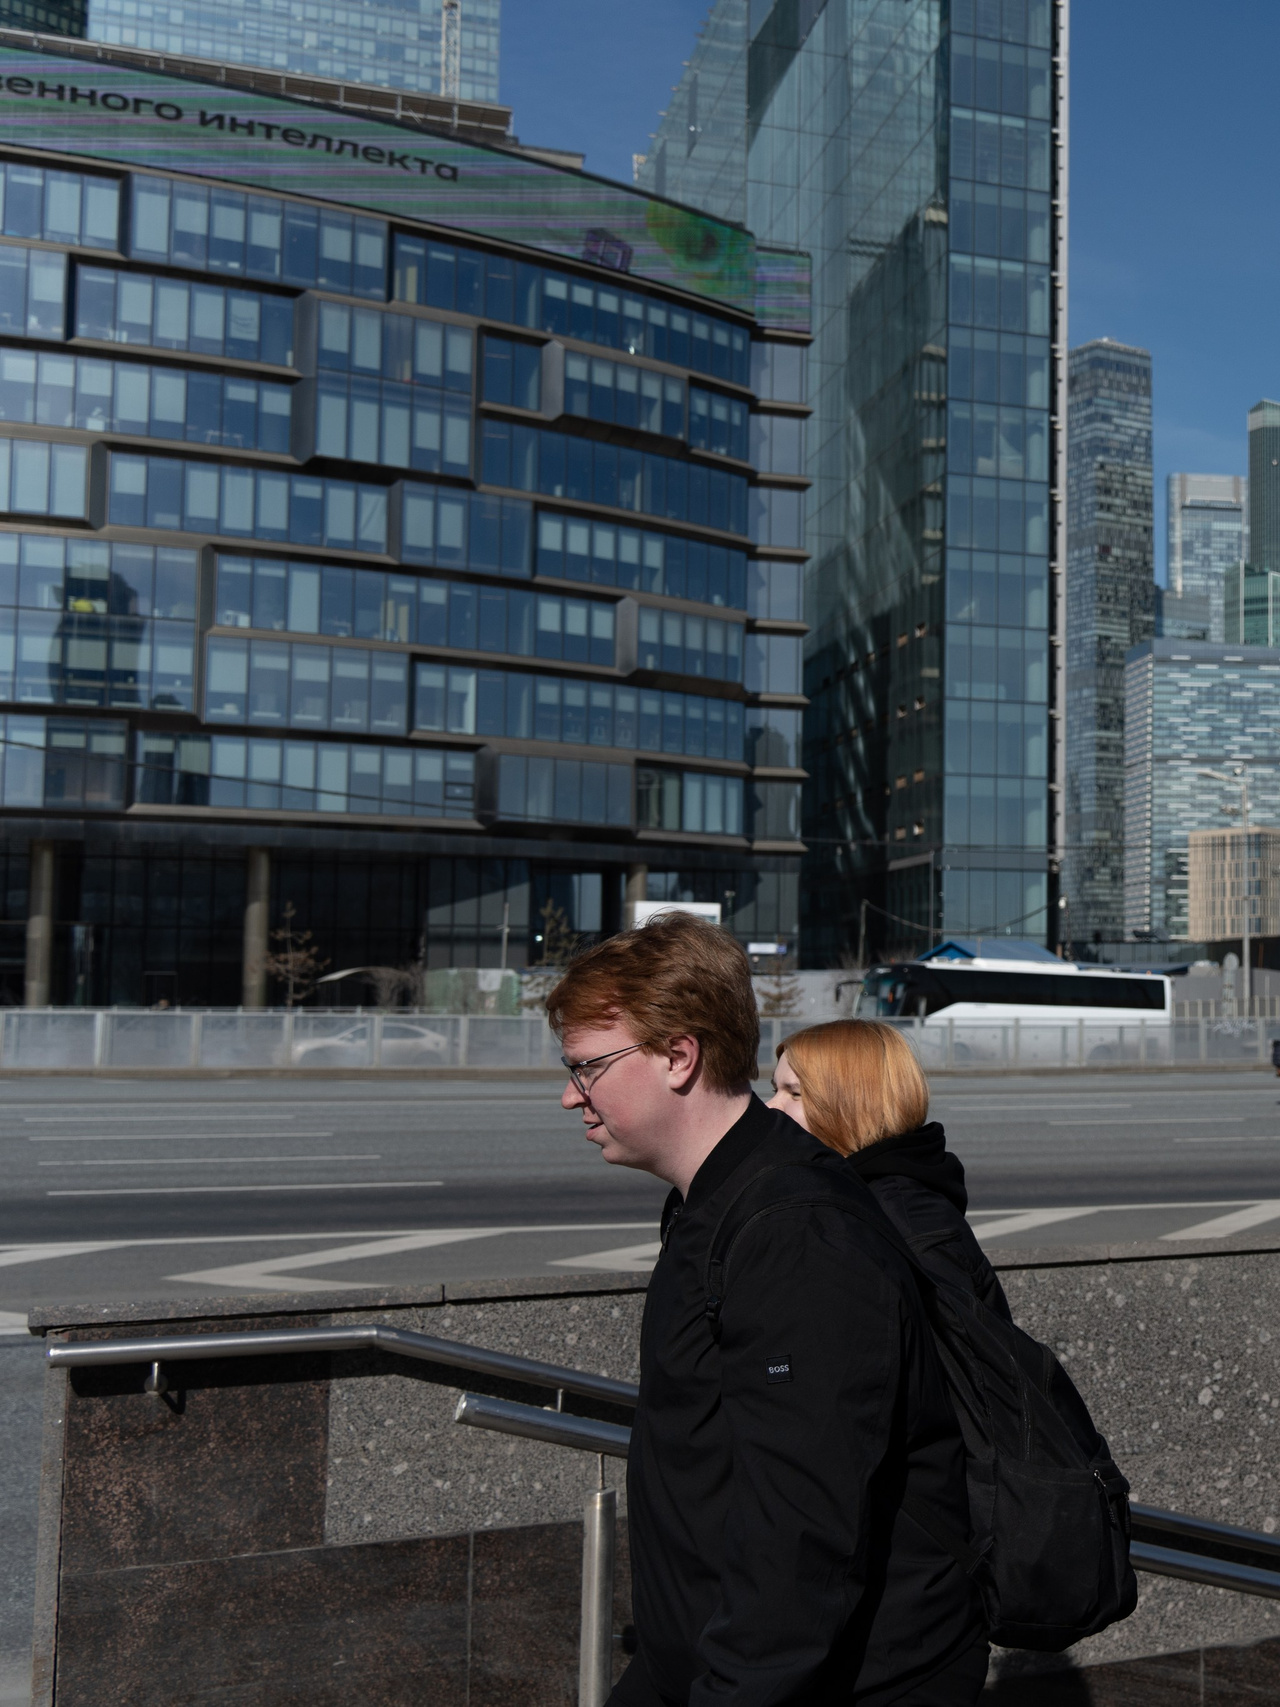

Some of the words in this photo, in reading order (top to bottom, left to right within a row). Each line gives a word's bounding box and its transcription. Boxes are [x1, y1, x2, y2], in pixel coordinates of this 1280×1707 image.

[0, 75, 184, 121] енного
[199, 109, 459, 183] интеллекта
[768, 1364, 790, 1374] BOSS
